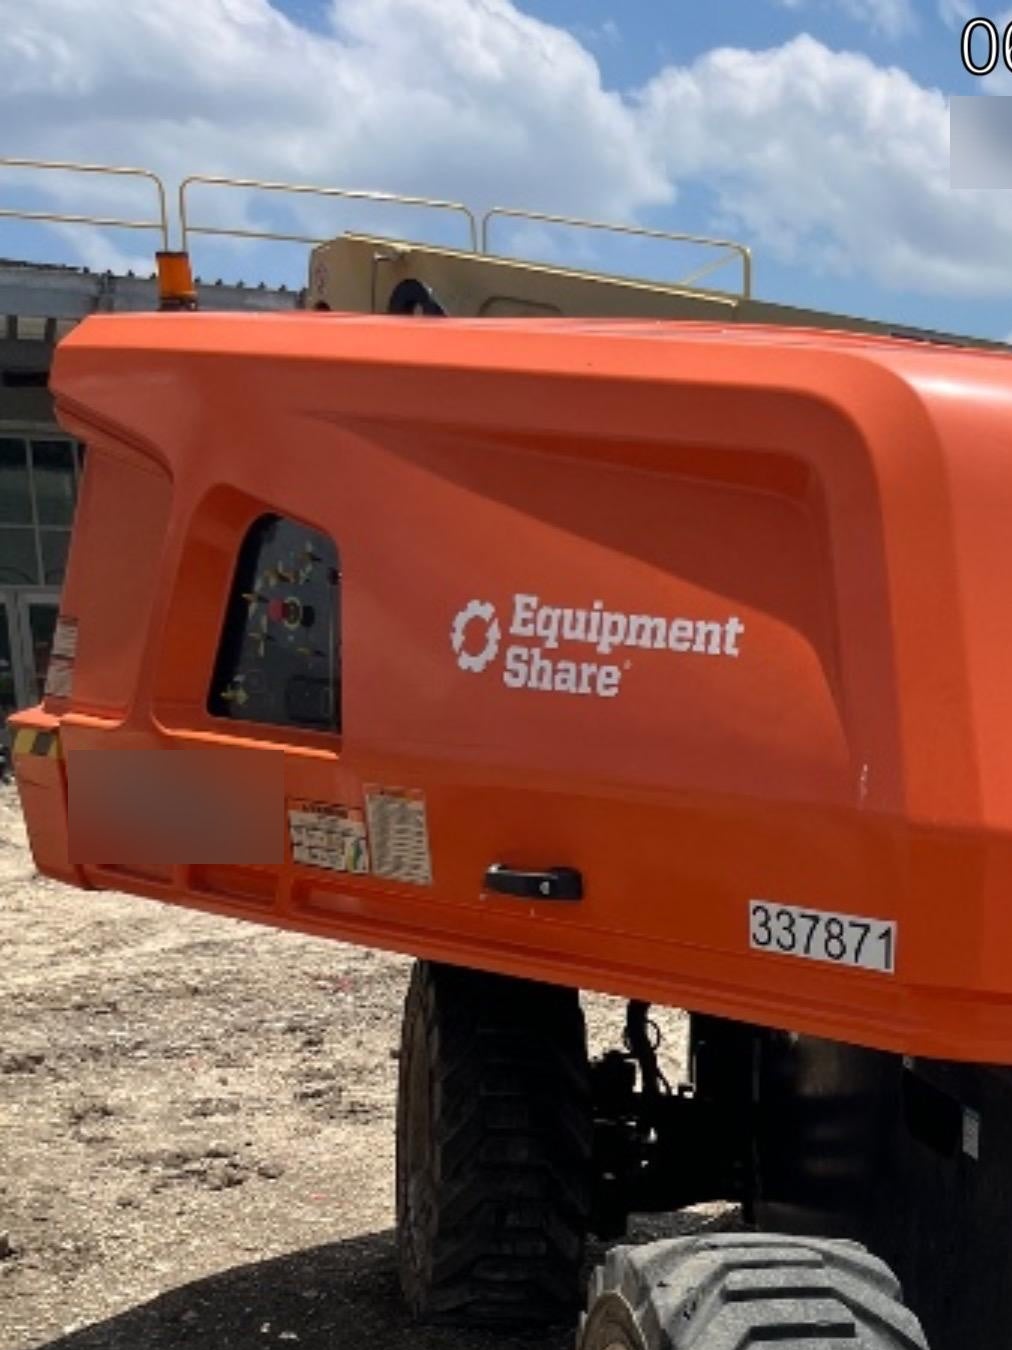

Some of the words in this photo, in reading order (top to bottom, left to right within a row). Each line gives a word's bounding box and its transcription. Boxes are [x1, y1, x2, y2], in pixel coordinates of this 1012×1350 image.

[510, 593, 744, 657] Equipment
[503, 645, 621, 697] Share
[752, 905, 892, 969] 337871
